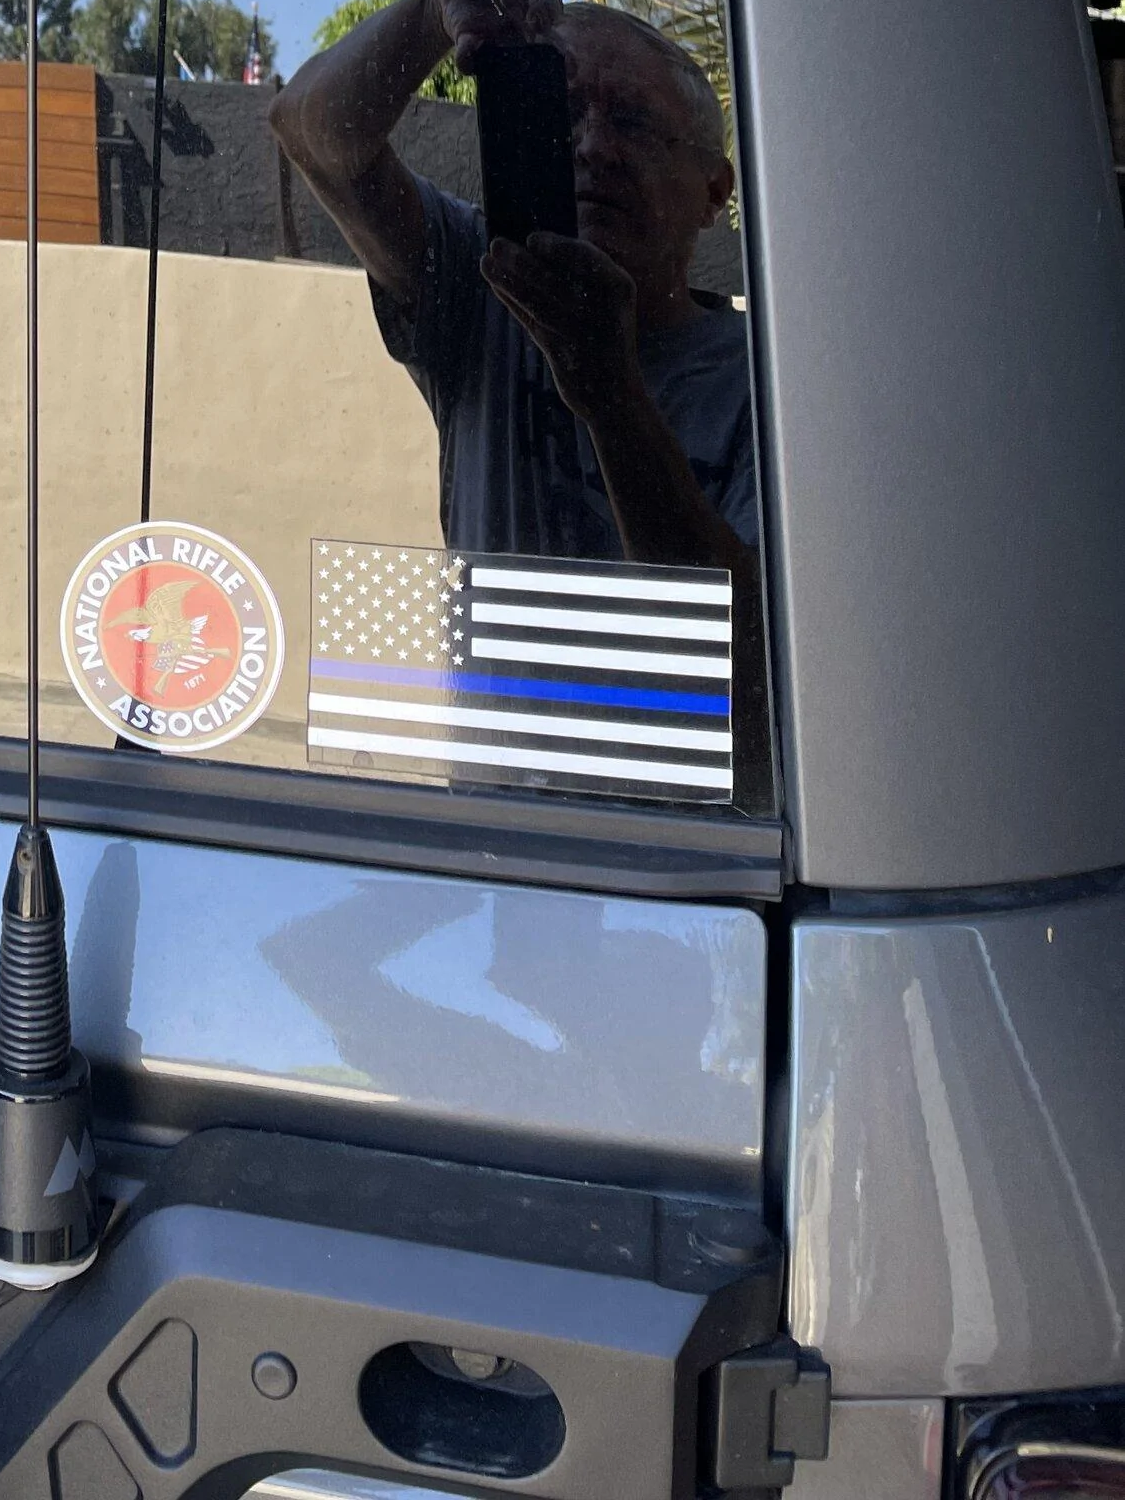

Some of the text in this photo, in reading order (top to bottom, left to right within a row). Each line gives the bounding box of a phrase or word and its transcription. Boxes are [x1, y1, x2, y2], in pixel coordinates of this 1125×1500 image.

[75, 538, 246, 670] NATIONAL RIFLE
[109, 627, 266, 737] ASSOCIATION
[183, 673, 206, 690] 1871
